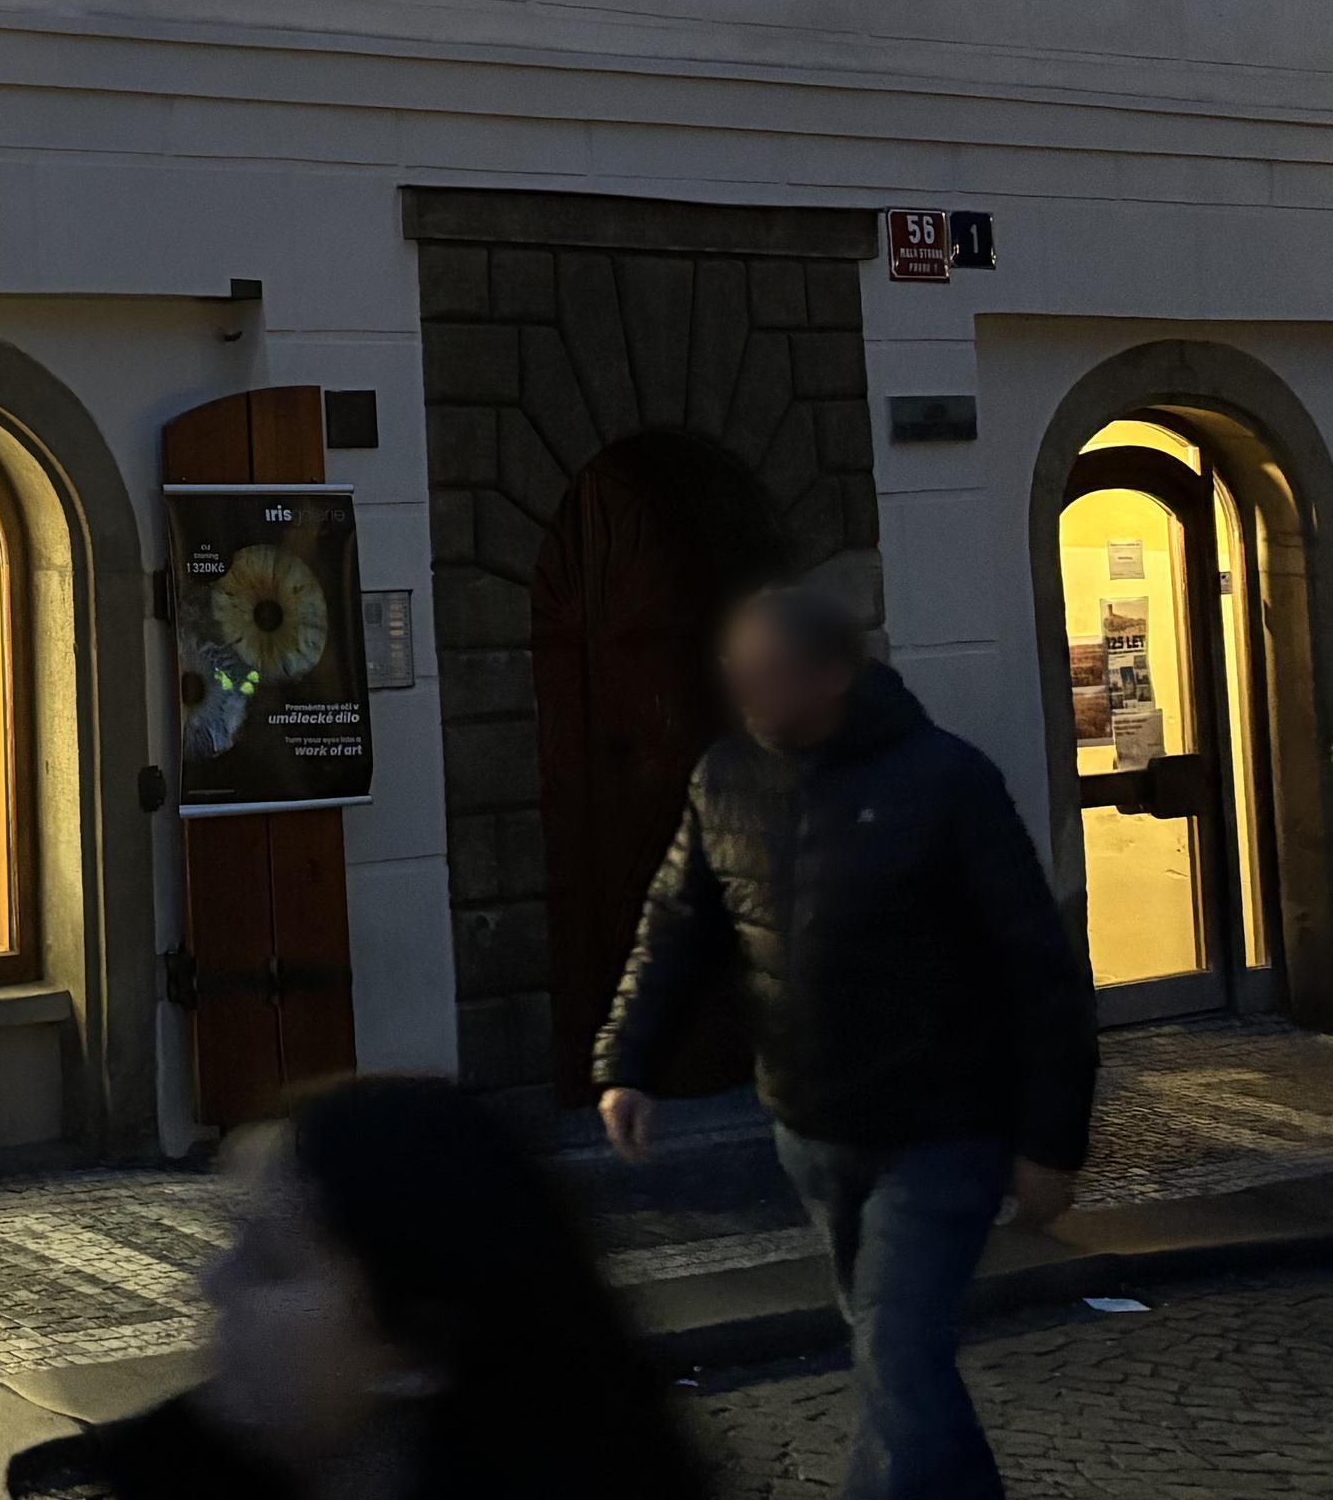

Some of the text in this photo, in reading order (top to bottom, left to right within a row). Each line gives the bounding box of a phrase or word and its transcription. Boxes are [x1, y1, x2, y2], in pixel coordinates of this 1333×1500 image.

[906, 215, 935, 244] 56
[969, 223, 980, 254] 1
[1126, 634, 1146, 649] LET
[294, 744, 362, 756] work of art
